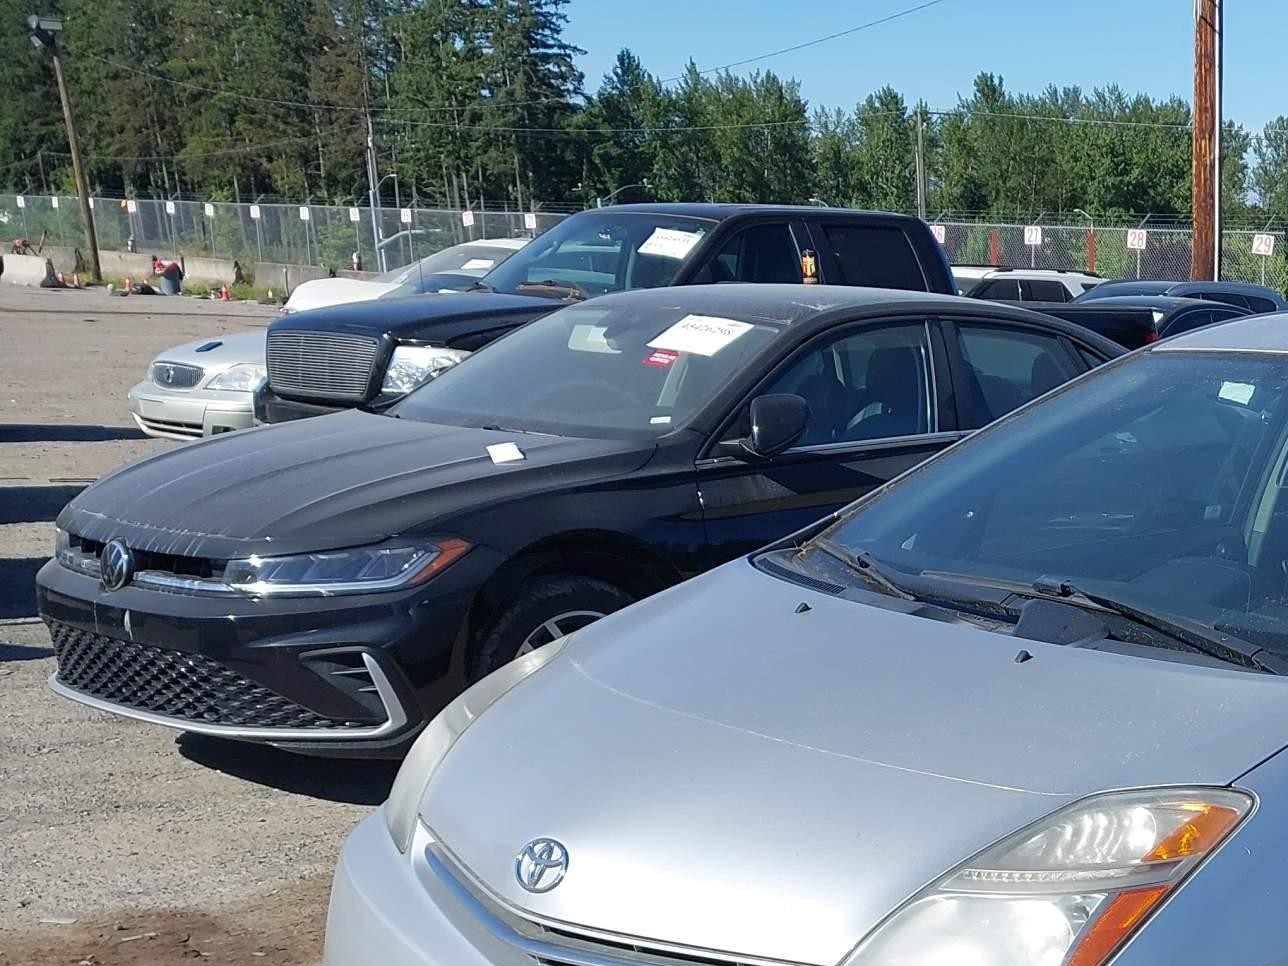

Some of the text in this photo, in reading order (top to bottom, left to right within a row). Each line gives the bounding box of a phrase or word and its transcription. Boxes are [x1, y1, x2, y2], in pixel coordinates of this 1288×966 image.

[1027, 227, 1039, 243] 27
[1129, 231, 1144, 248] 28
[1254, 236, 1272, 253] 29
